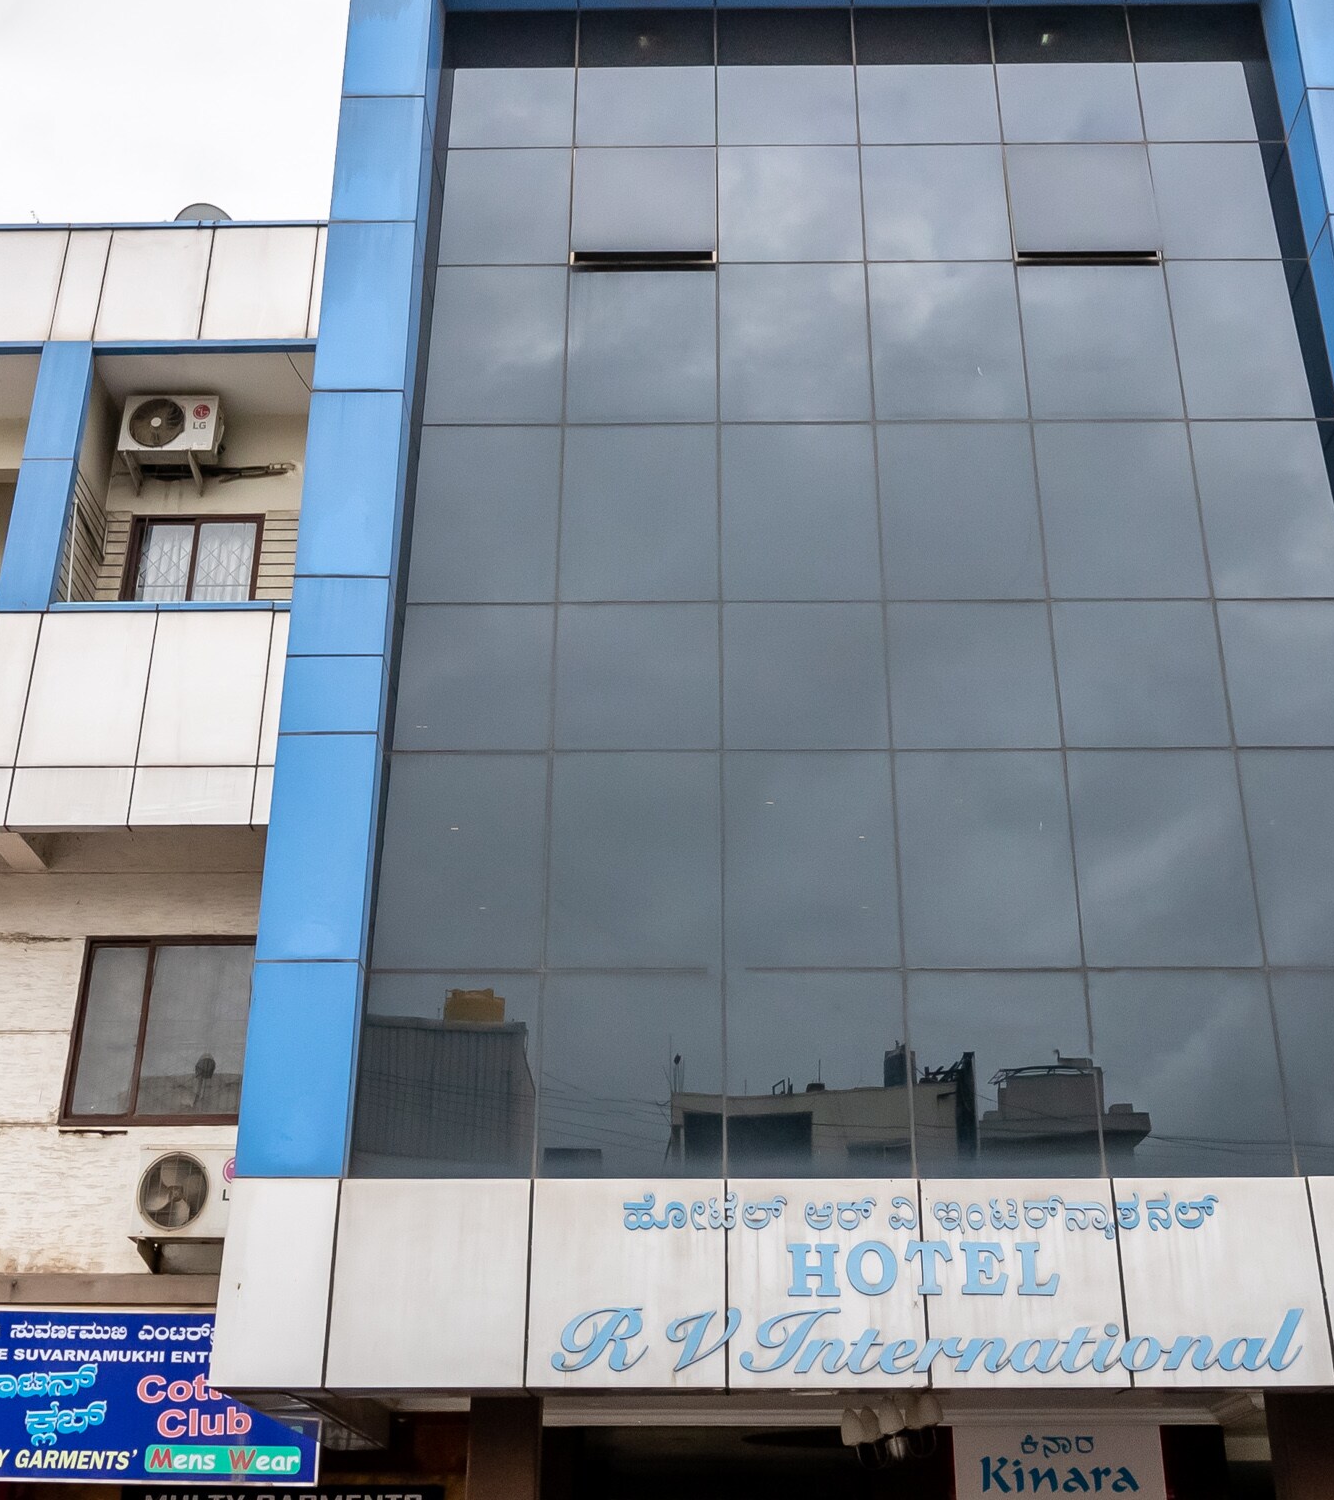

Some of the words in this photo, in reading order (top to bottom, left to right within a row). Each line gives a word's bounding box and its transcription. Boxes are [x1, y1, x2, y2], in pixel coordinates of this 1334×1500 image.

[192, 421, 207, 431] LG
[622, 1192, 788, 1231] ಹೋಟೆಲ್
[804, 1195, 877, 1231] ಆರ್
[888, 1195, 918, 1231] ವಿ
[787, 1240, 1060, 1297] HOTEL
[10, 1320, 128, 1340] ಸುವರ್ಣಮುಖಿ
[550, 1304, 649, 1372] R
[666, 1307, 742, 1373] V
[739, 1307, 1305, 1375] International
[13, 1348, 166, 1364] SUVARNAMUKHI
[156, 1406, 253, 1438] Club
[148, 1448, 216, 1471] Mens
[228, 1449, 301, 1472] Wear
[1020, 1434, 1095, 1458] ಕಿನಾರ
[980, 1456, 1140, 1493] Kinara
